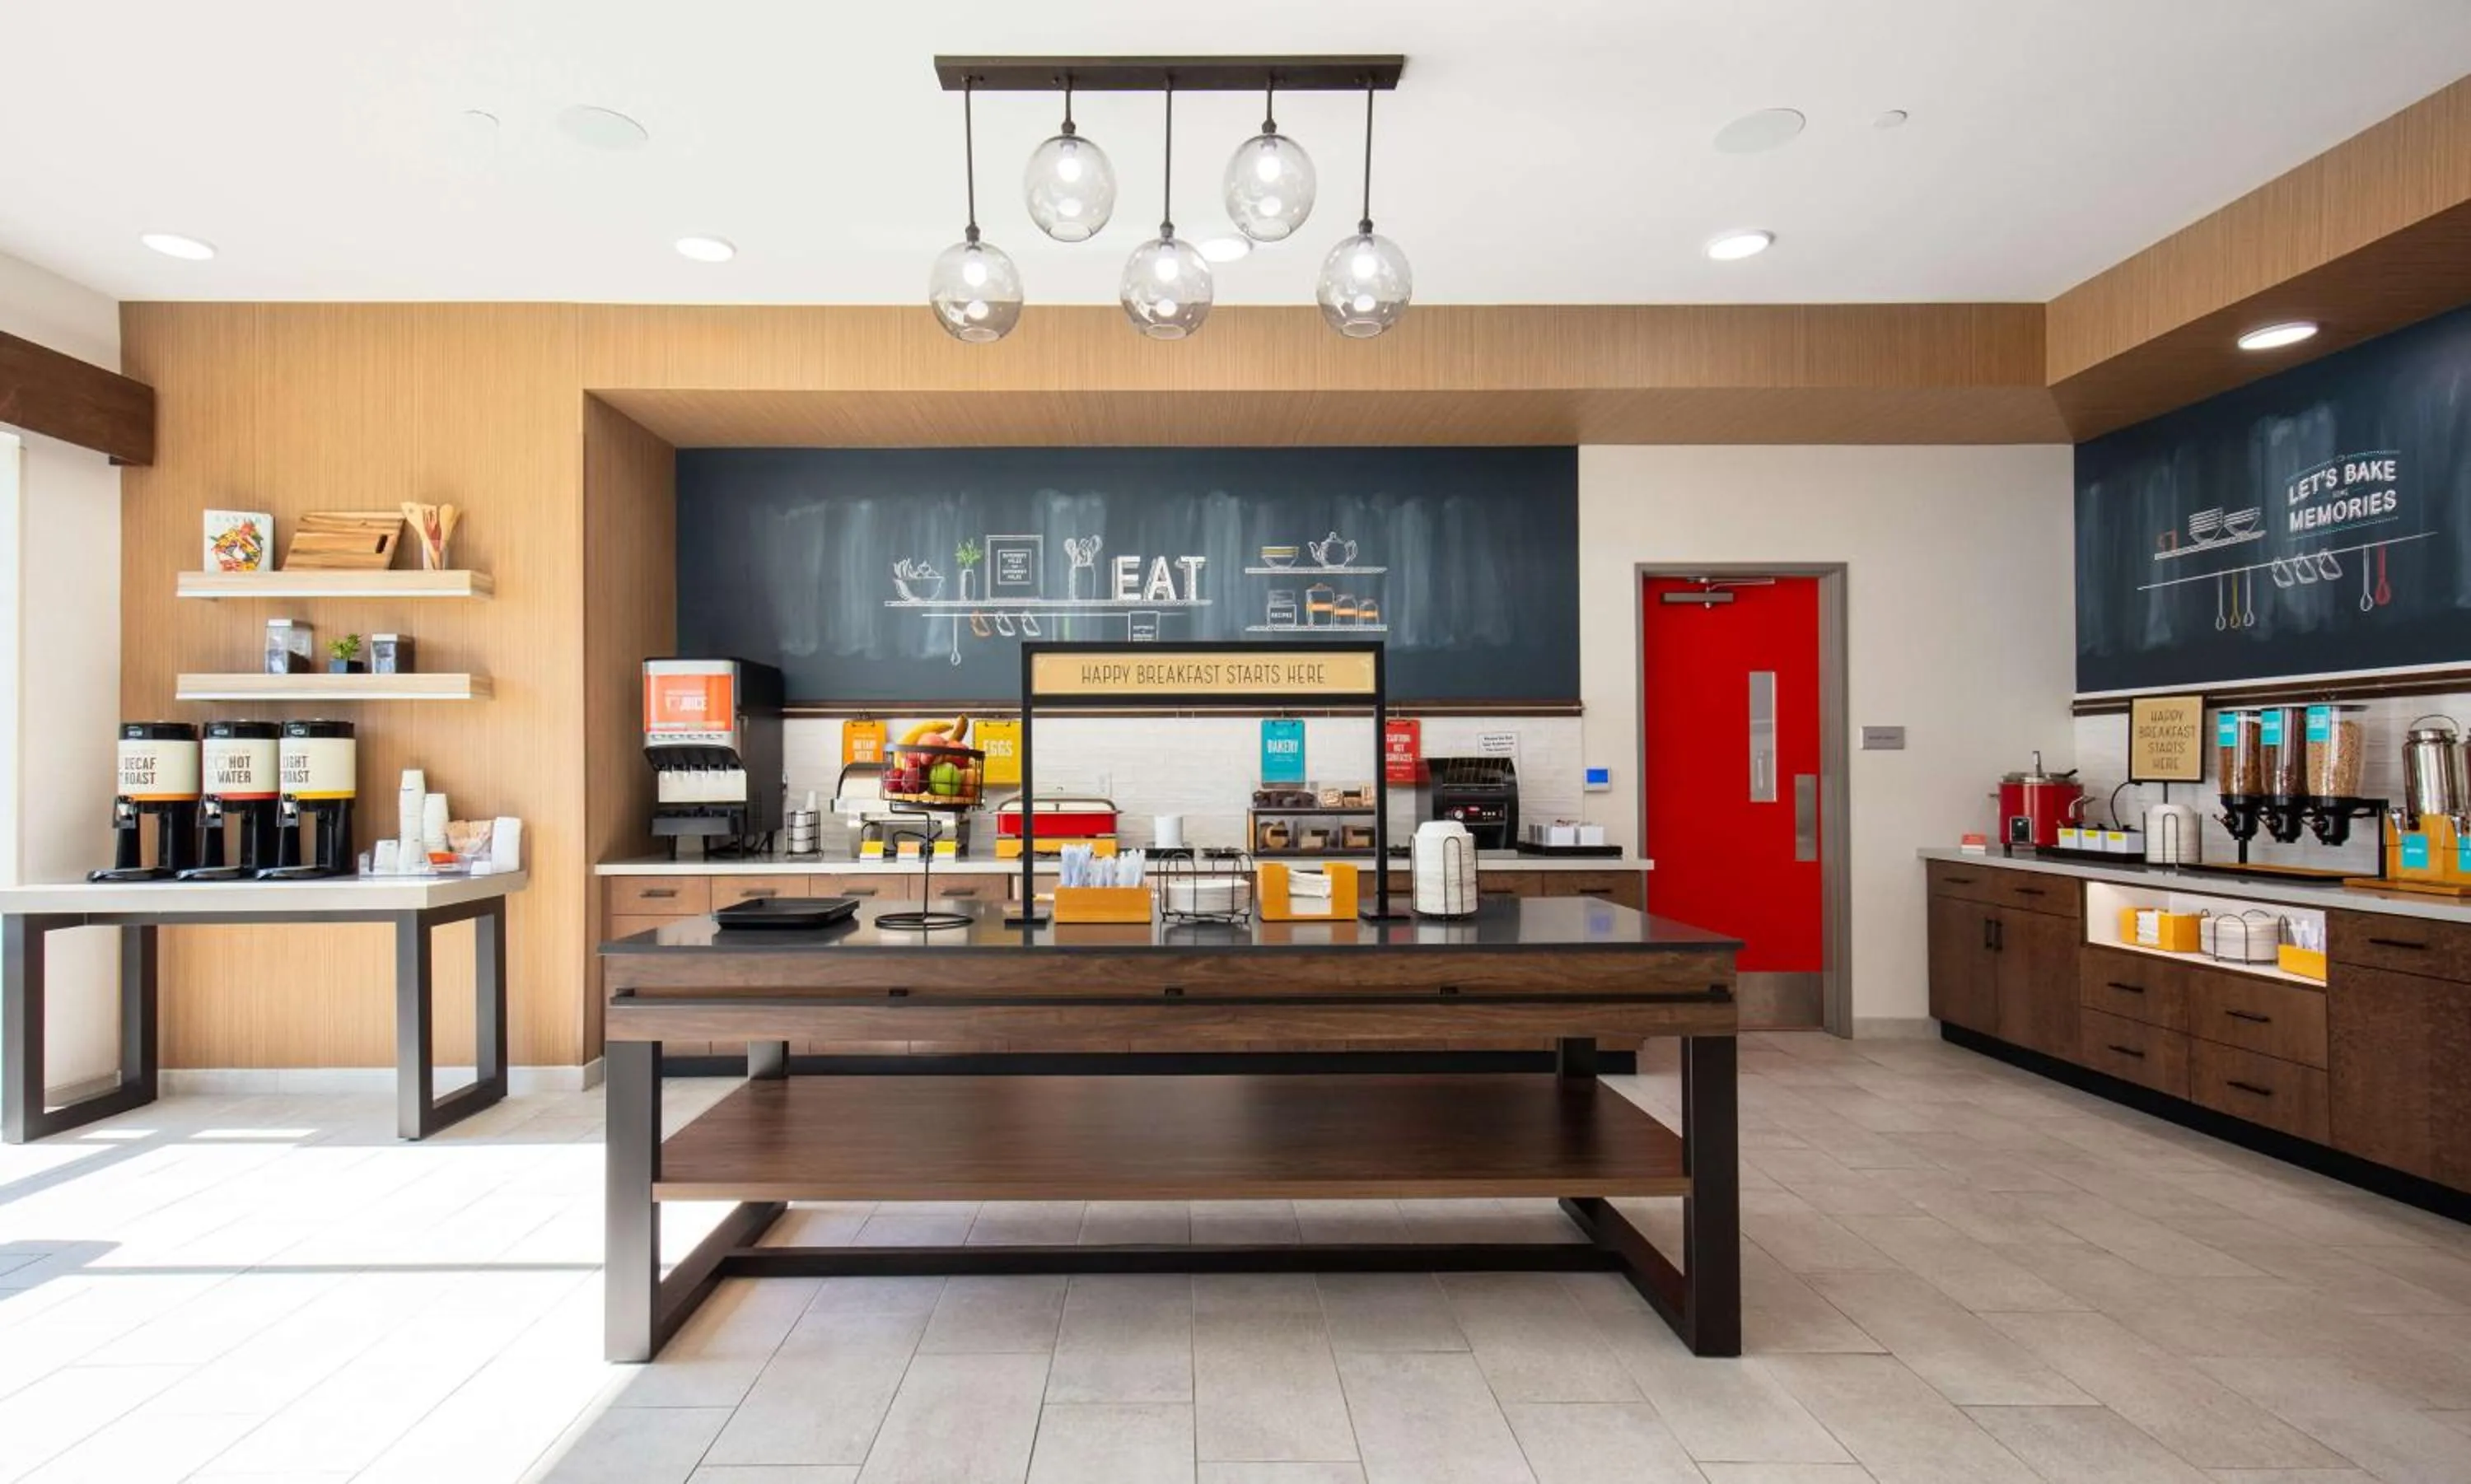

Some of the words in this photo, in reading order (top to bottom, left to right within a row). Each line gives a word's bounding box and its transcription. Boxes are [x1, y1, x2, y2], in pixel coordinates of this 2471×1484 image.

[2289, 468, 2338, 506] LET'S
[2344, 460, 2397, 485] BAKE
[2290, 489, 2397, 532] MEMORIES
[1112, 556, 1206, 600] EAT
[1081, 665, 1131, 684] HAPPY
[1137, 665, 1220, 684] BREAKFAST
[1226, 665, 1281, 684] STARTS
[1287, 664, 1324, 684] HERE
[2151, 710, 2184, 722] HAPPY
[2139, 725, 2196, 739] BREAKFAST
[983, 740, 1013, 756] EGGS
[1267, 739, 1299, 754] BAKERY
[2147, 740, 2187, 754] STARTS
[228, 755, 251, 768] HOT
[217, 770, 251, 784] WATER
